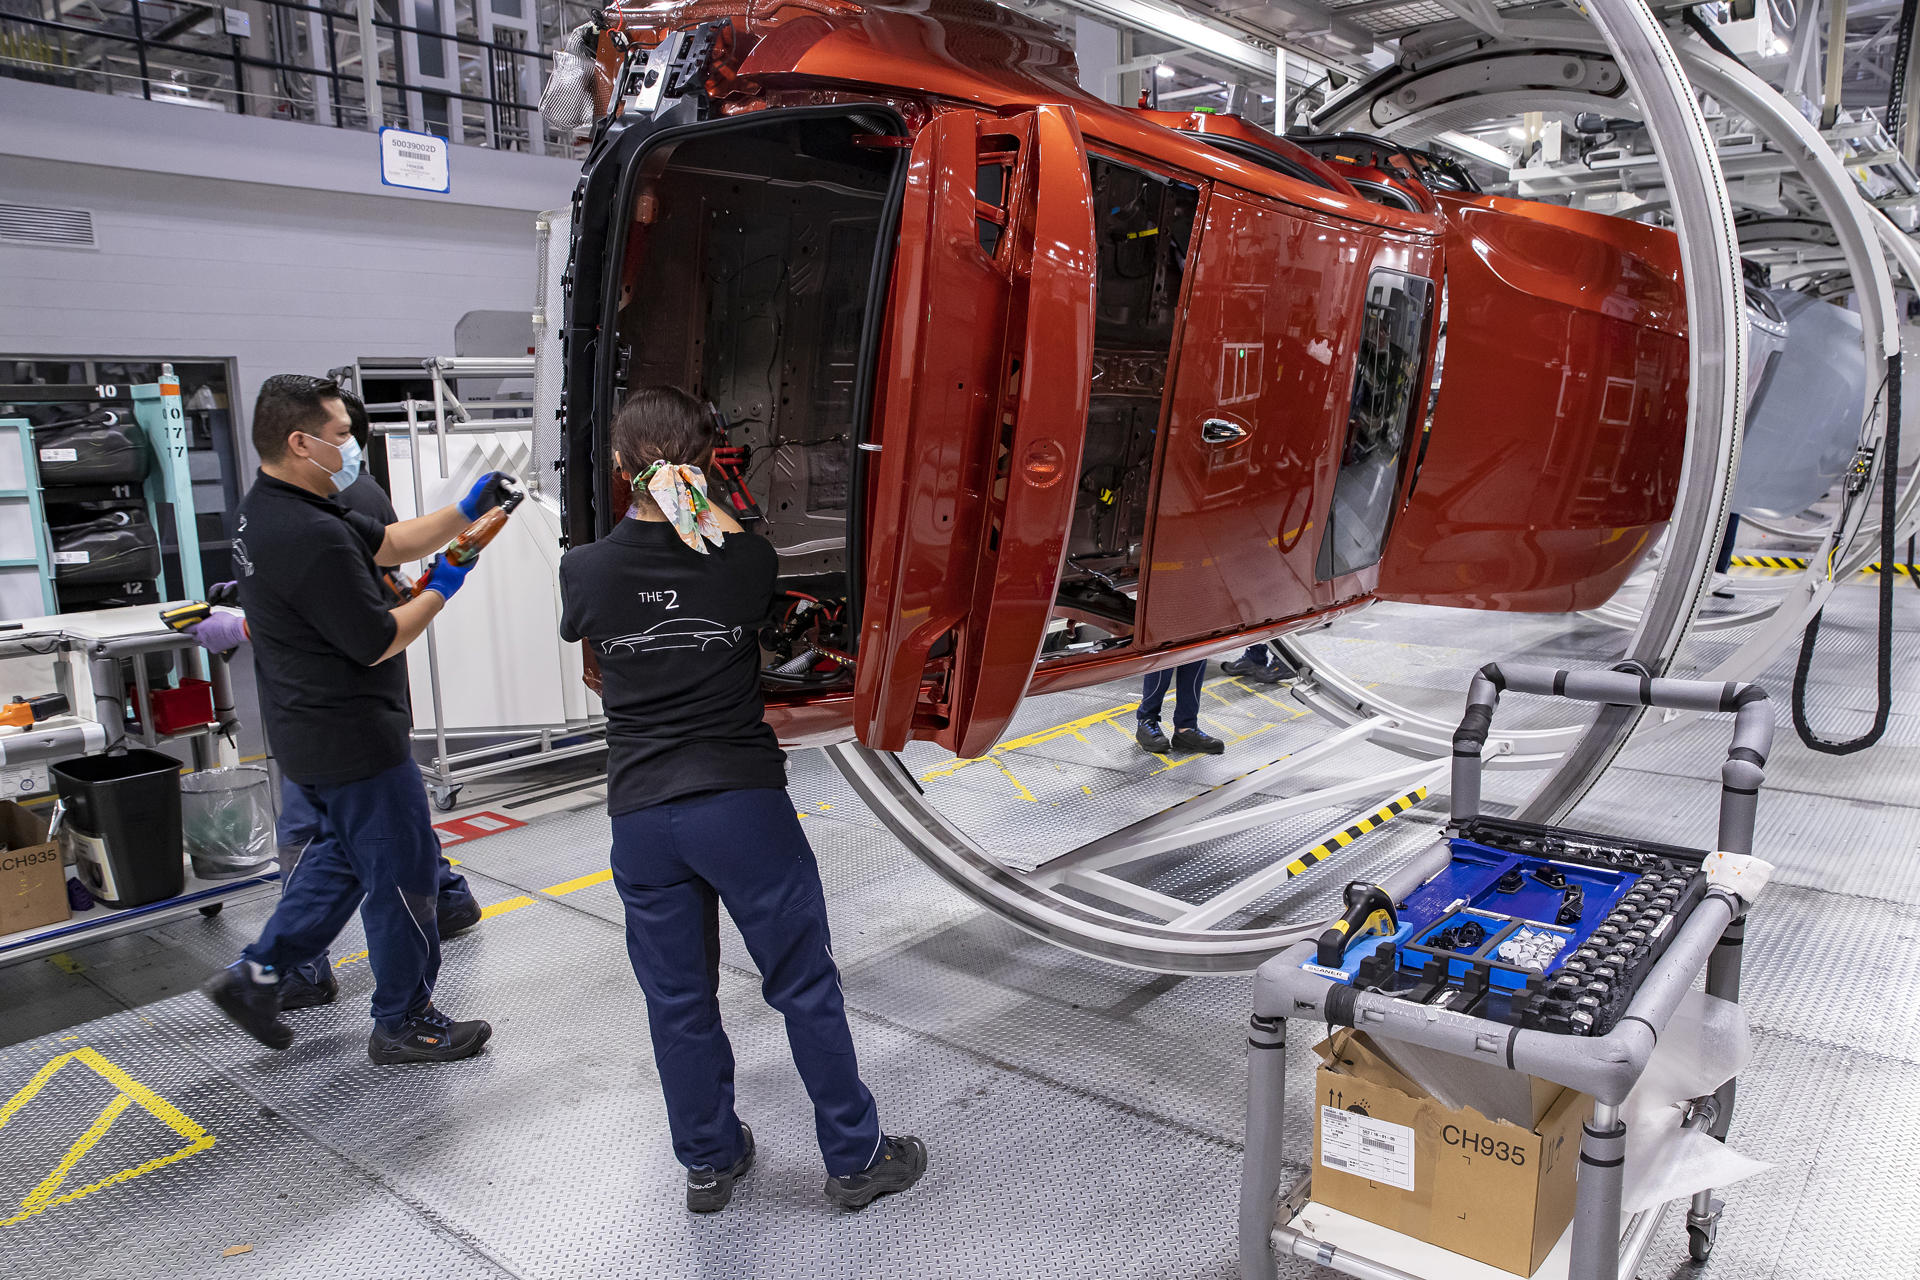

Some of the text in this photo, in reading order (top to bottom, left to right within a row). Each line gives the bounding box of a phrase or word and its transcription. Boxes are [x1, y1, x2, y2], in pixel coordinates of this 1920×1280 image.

[391, 138, 437, 153] 50039002D
[95, 384, 118, 398] 10
[112, 484, 130, 498] 11
[122, 582, 143, 594] 12
[638, 589, 680, 610] THE 2
[0, 850, 57, 872] CH935
[1442, 1124, 1526, 1166] CH935
